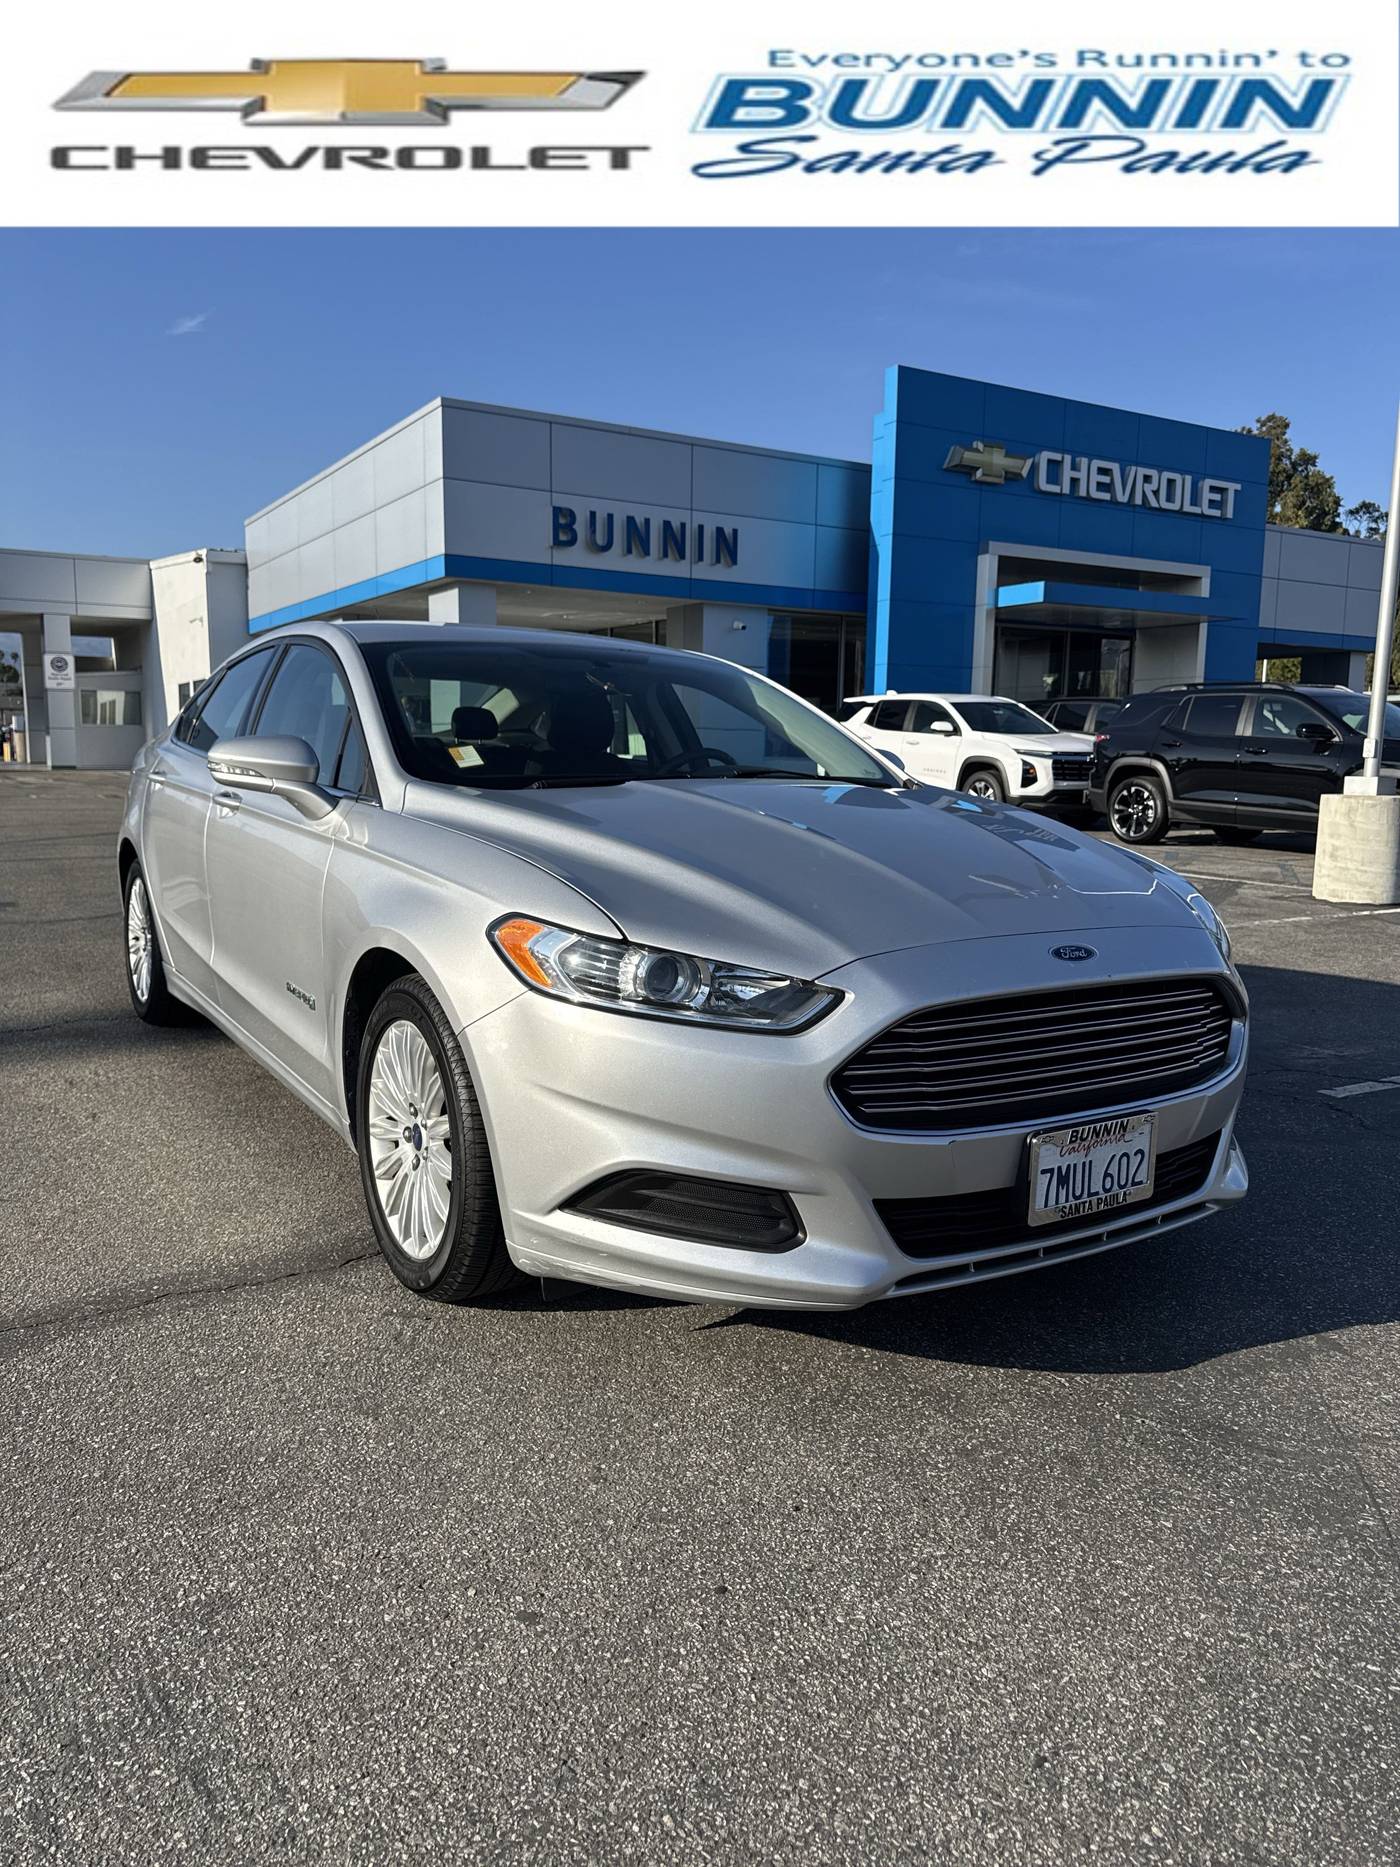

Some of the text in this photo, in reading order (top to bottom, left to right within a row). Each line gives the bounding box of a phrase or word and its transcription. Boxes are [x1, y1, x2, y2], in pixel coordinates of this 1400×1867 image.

[1035, 450, 1242, 519] CHEVROLET
[551, 505, 739, 567] BUNNIN
[1060, 946, 1088, 959] Ford
[1068, 1119, 1131, 1145] BUNNIN
[1039, 1148, 1146, 1209] 7MUL602
[1060, 1192, 1129, 1219] SANTA PAULA
